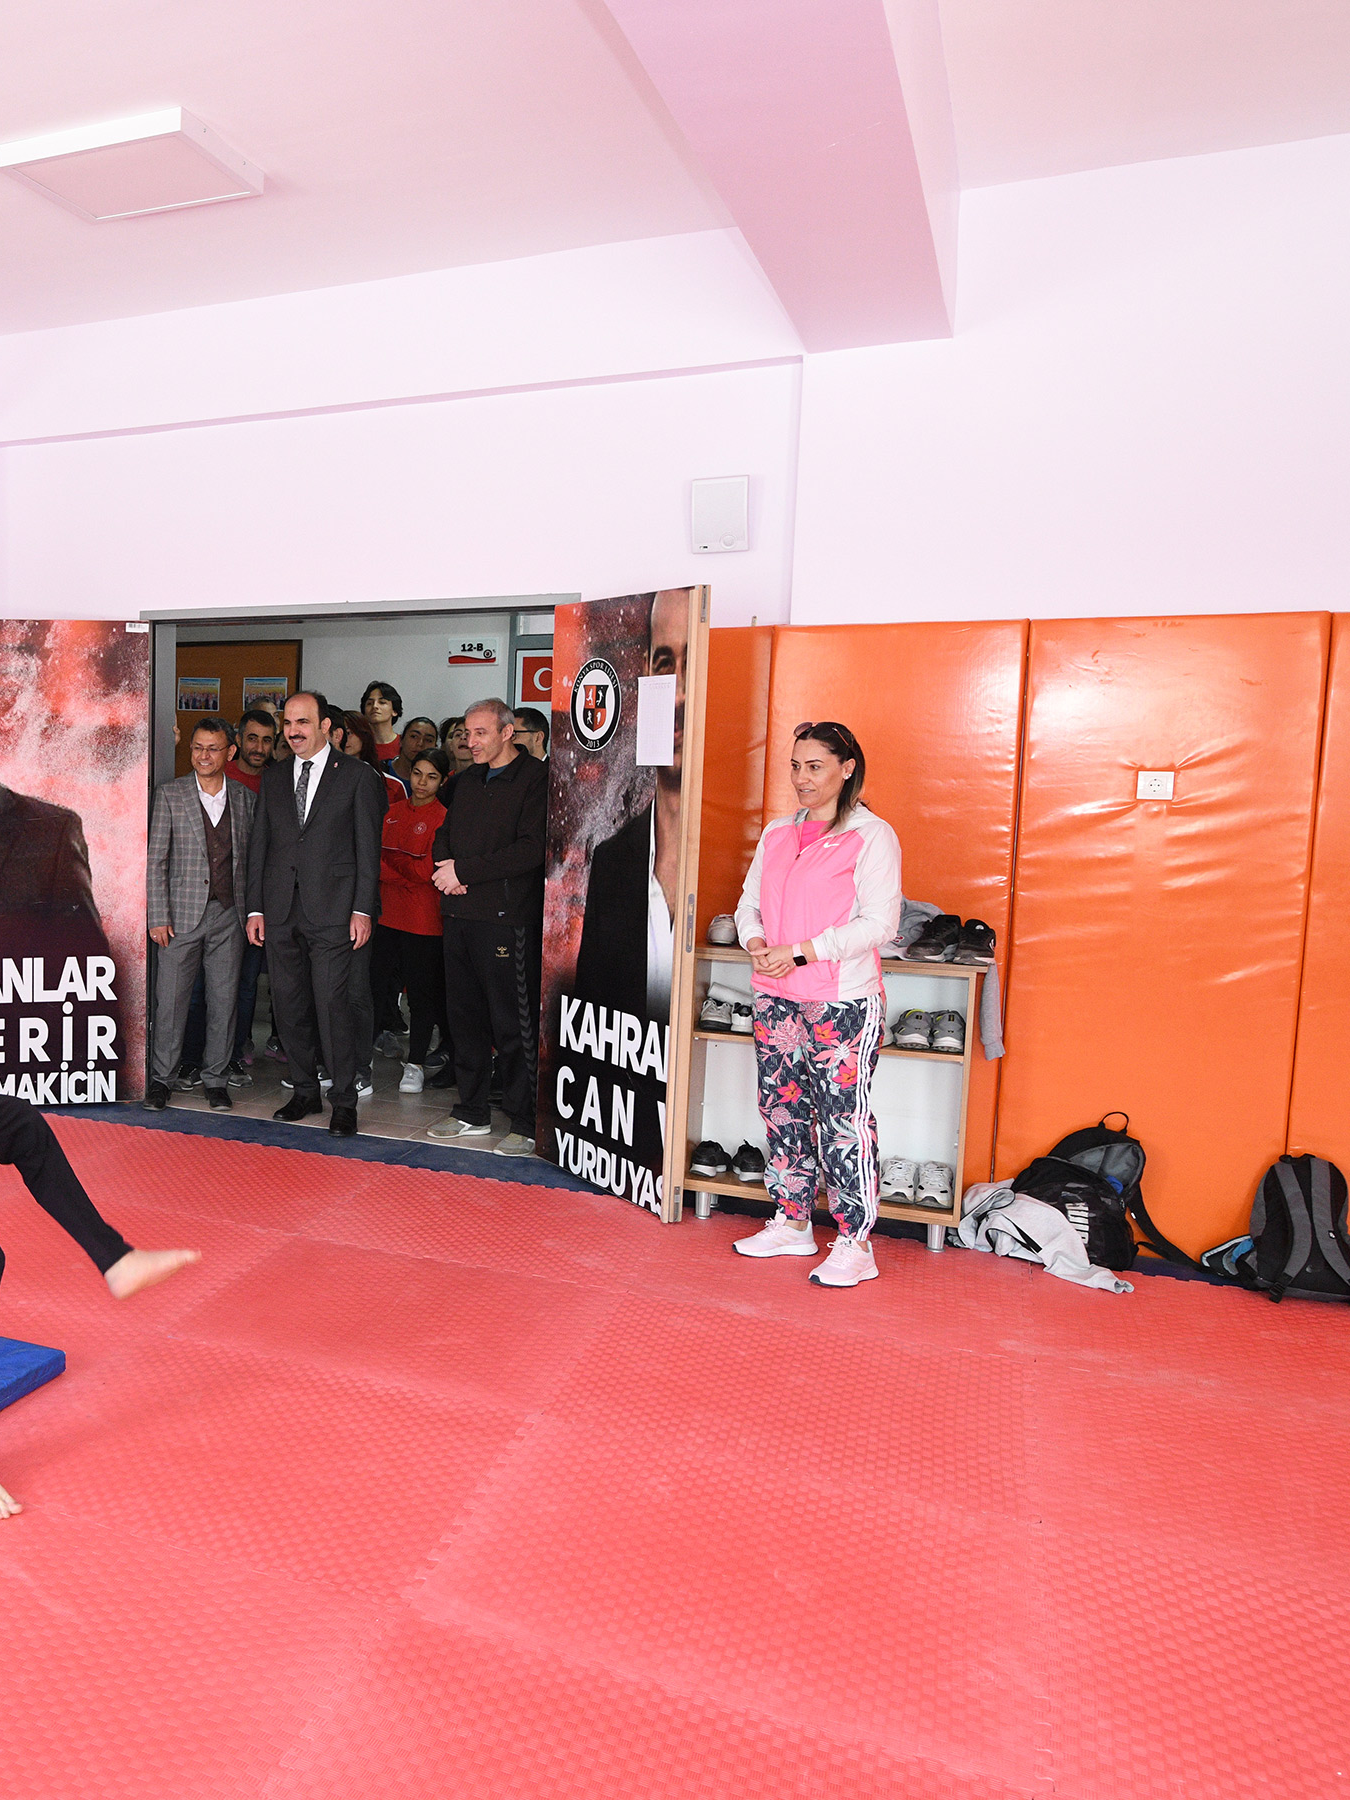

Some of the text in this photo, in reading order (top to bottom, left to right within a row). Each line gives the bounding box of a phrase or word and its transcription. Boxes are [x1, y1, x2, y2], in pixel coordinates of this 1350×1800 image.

[461, 643, 484, 652] 12-B
[586, 740, 600, 748] 2013
[556, 1065, 635, 1147] CAN
